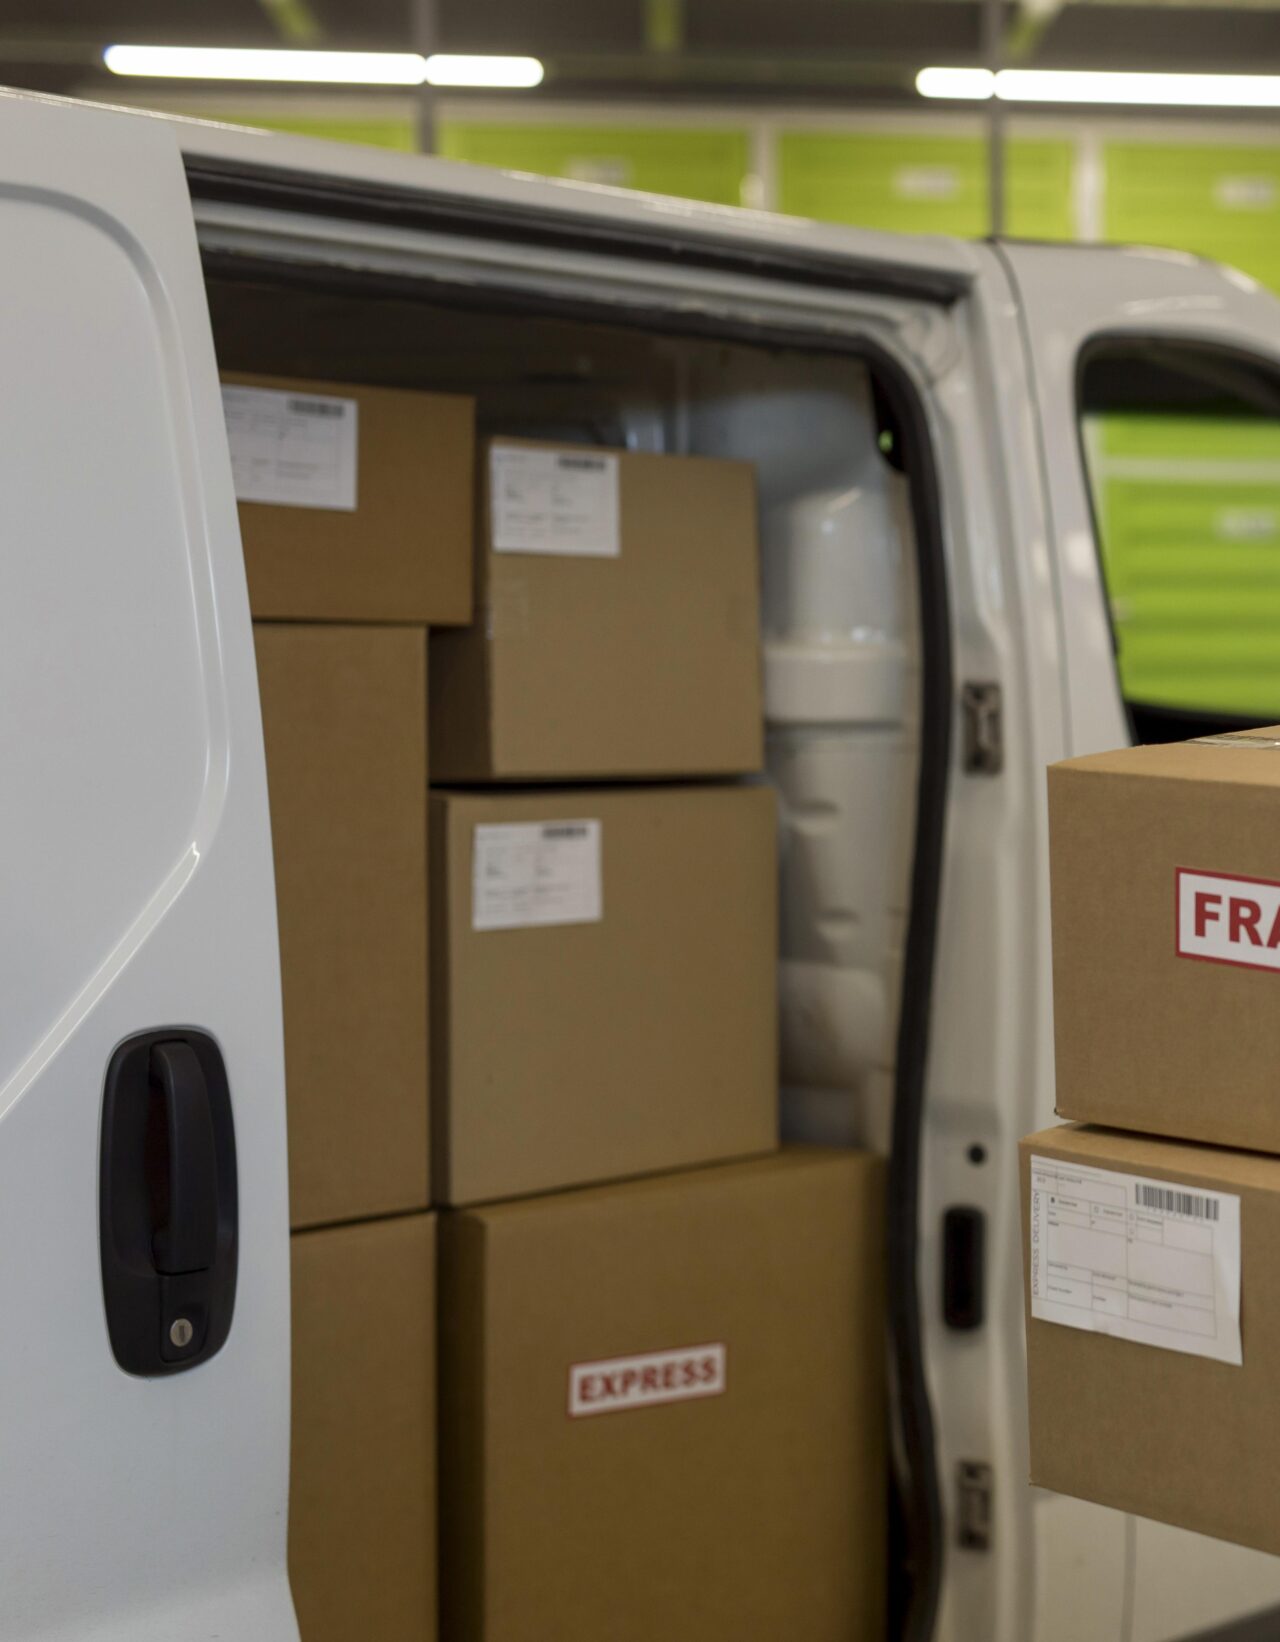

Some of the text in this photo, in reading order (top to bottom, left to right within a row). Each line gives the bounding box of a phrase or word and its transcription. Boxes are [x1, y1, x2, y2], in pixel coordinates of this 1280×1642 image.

[1032, 1189, 1041, 1296] EXPRESS DELIVERY
[579, 1355, 717, 1404] EXPRESS
